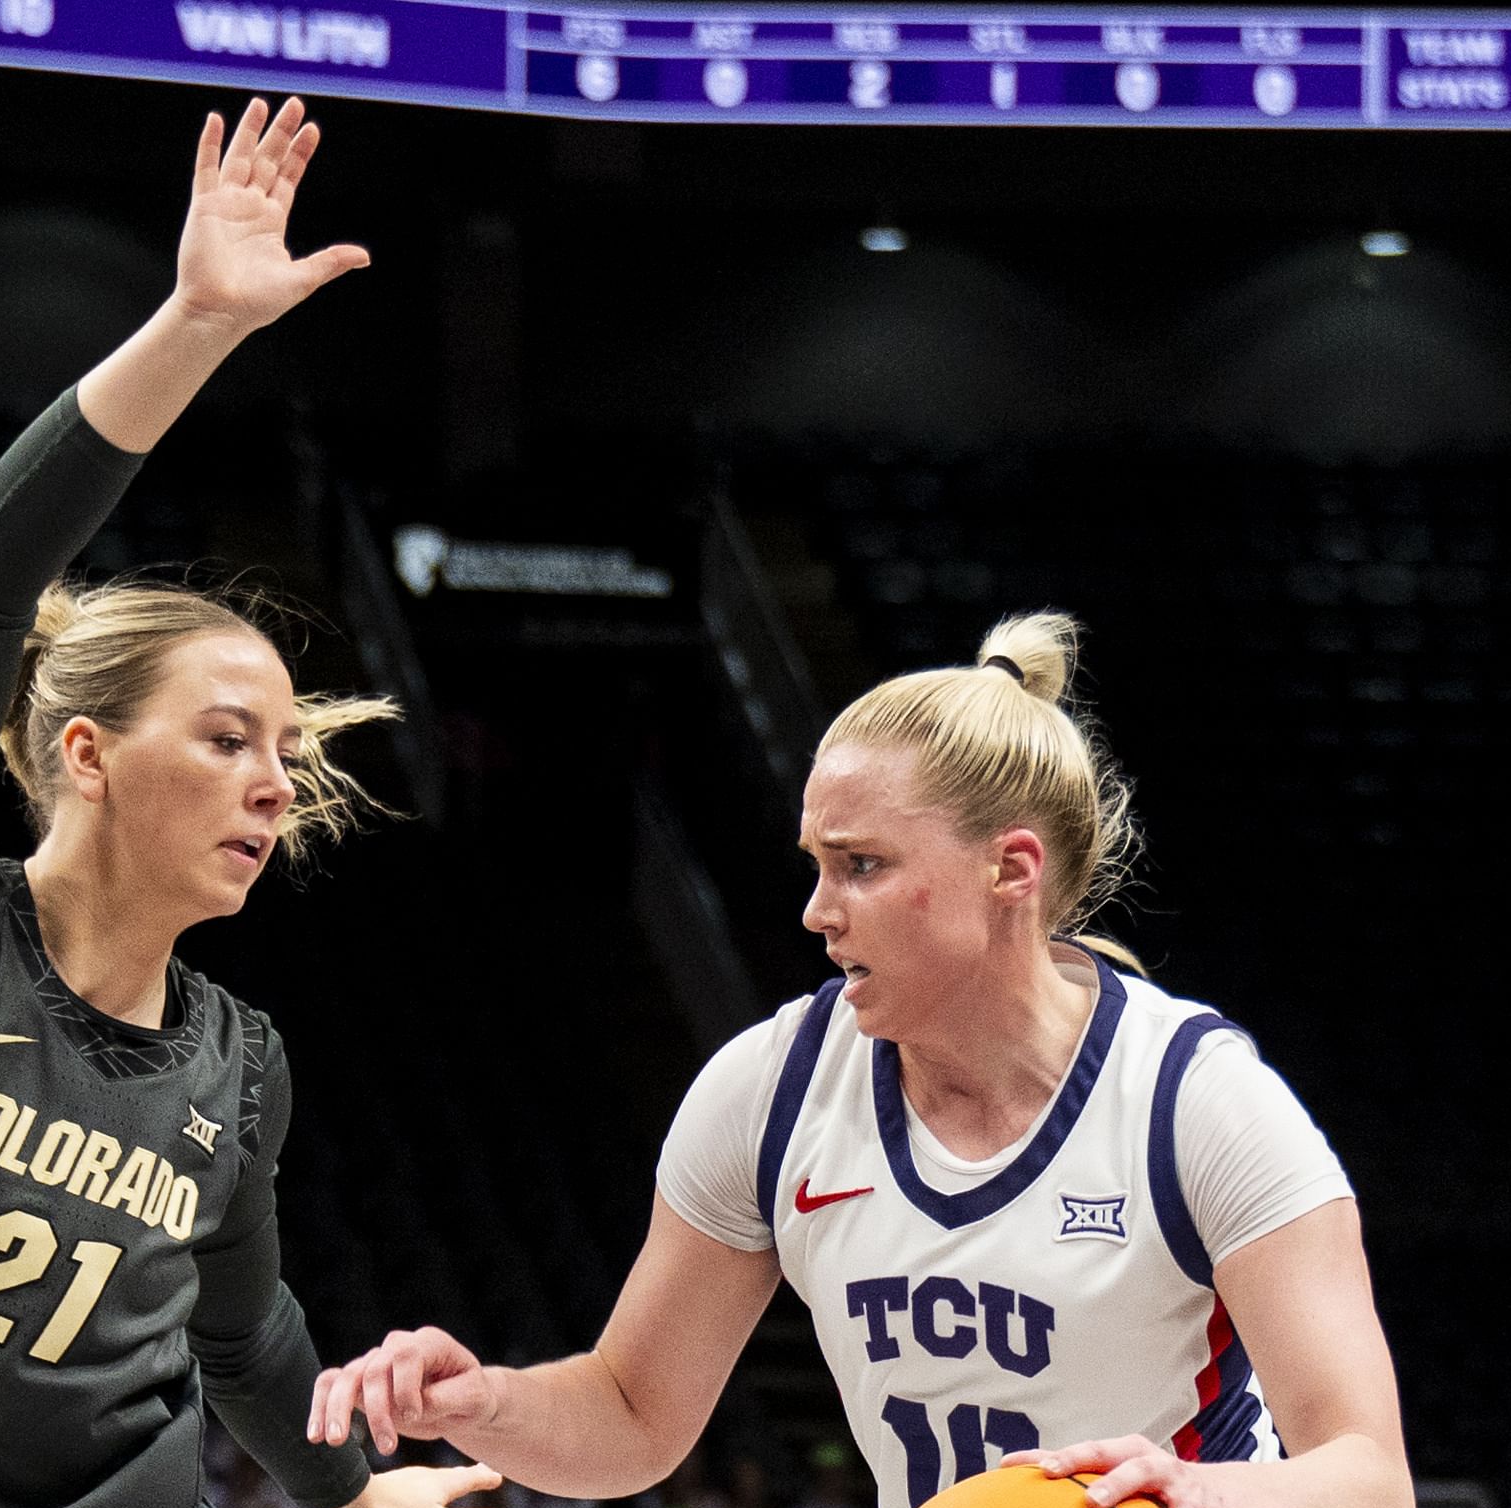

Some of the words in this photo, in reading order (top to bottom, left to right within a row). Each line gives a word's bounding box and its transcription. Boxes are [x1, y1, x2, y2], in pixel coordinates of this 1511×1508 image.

[1403, 32, 1505, 65] TEAM
[849, 58, 891, 108] 2
[991, 62, 1017, 109] 1
[1398, 70, 1509, 110] STATS
[846, 1276, 1055, 1377] TCU
